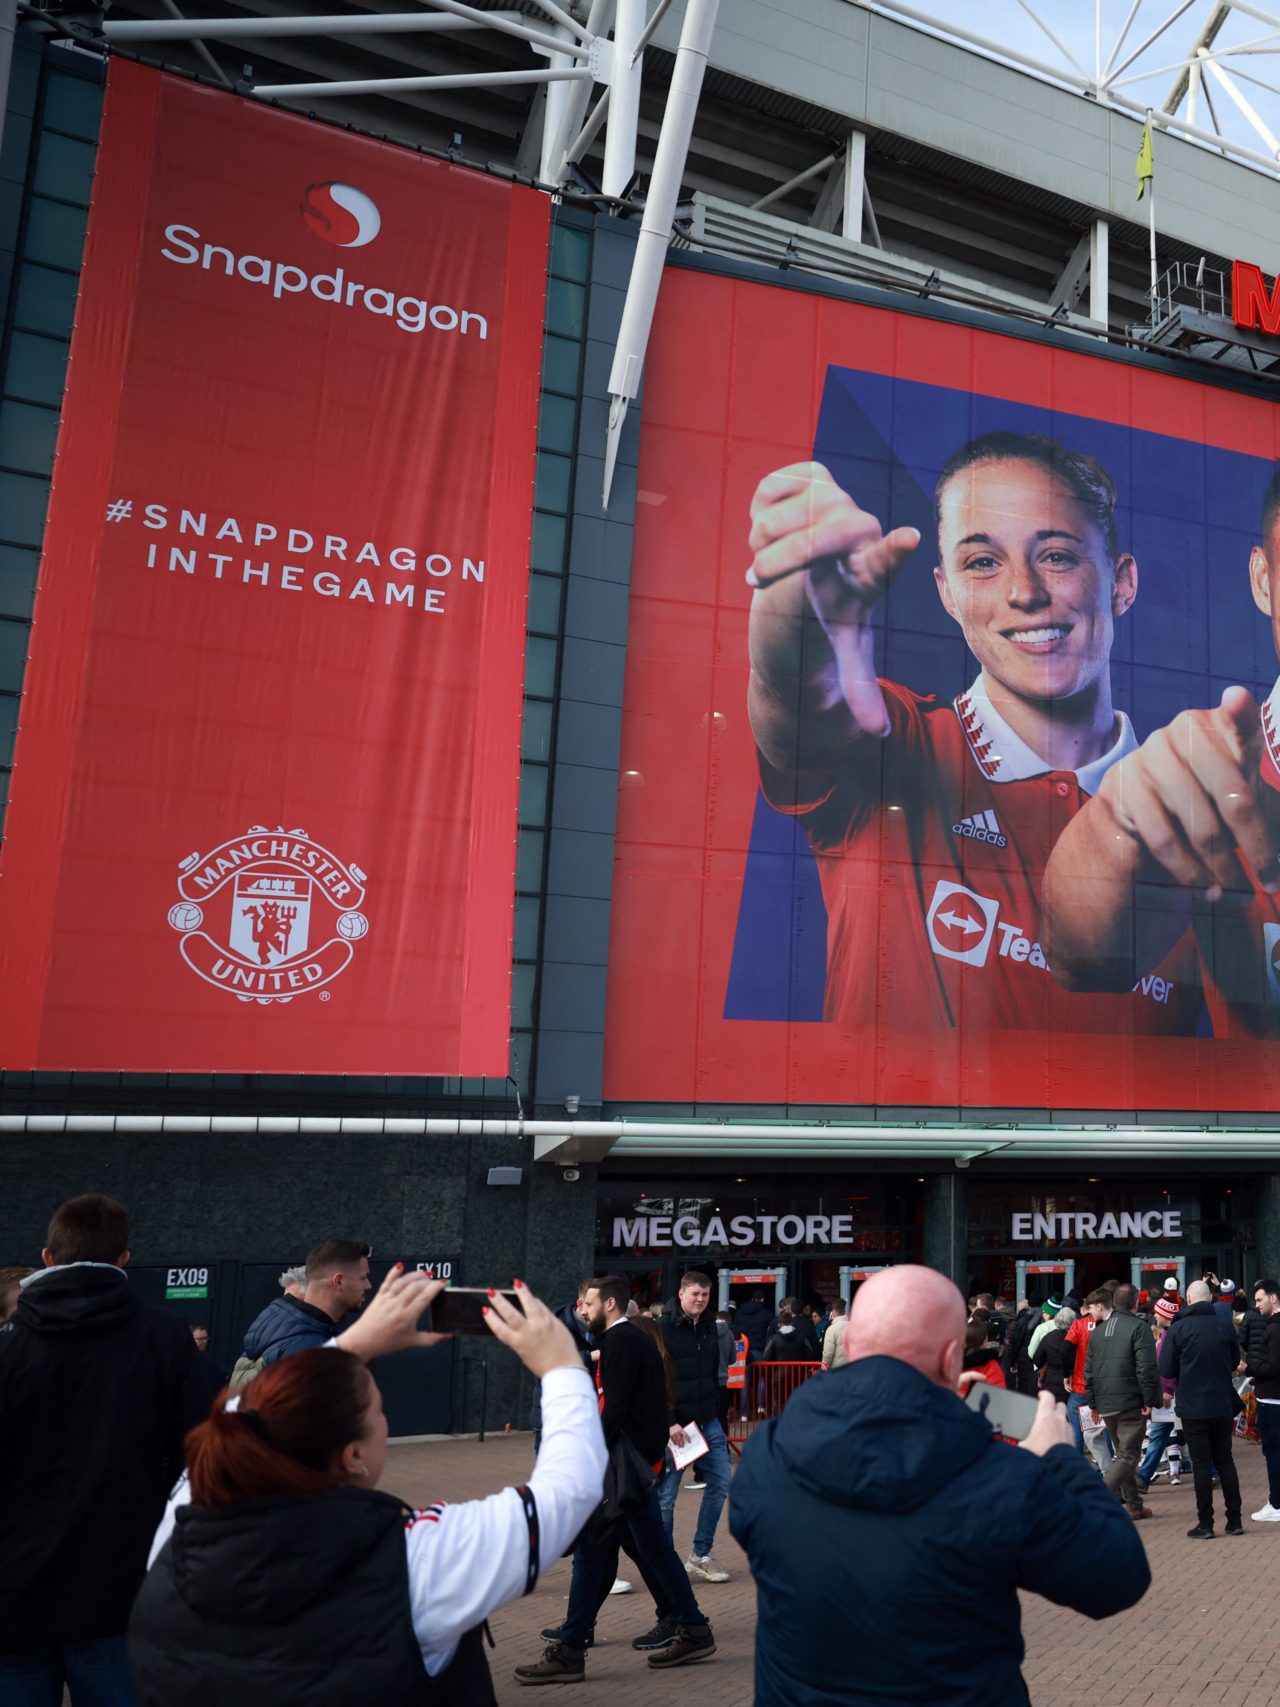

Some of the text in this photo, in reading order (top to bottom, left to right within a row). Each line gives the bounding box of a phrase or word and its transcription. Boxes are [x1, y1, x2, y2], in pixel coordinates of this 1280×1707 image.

[161, 224, 488, 339] Snapdragon
[106, 498, 485, 582] #SNAPDRAGON
[147, 543, 446, 613] INTHEGAME
[952, 822, 1006, 847] adidas
[193, 840, 351, 900] MANCHESTER
[211, 958, 323, 990] UNITED
[612, 1214, 854, 1248] MEGASTORE
[1012, 1211, 1182, 1240] ENTRANCE
[166, 1268, 209, 1287] EX09
